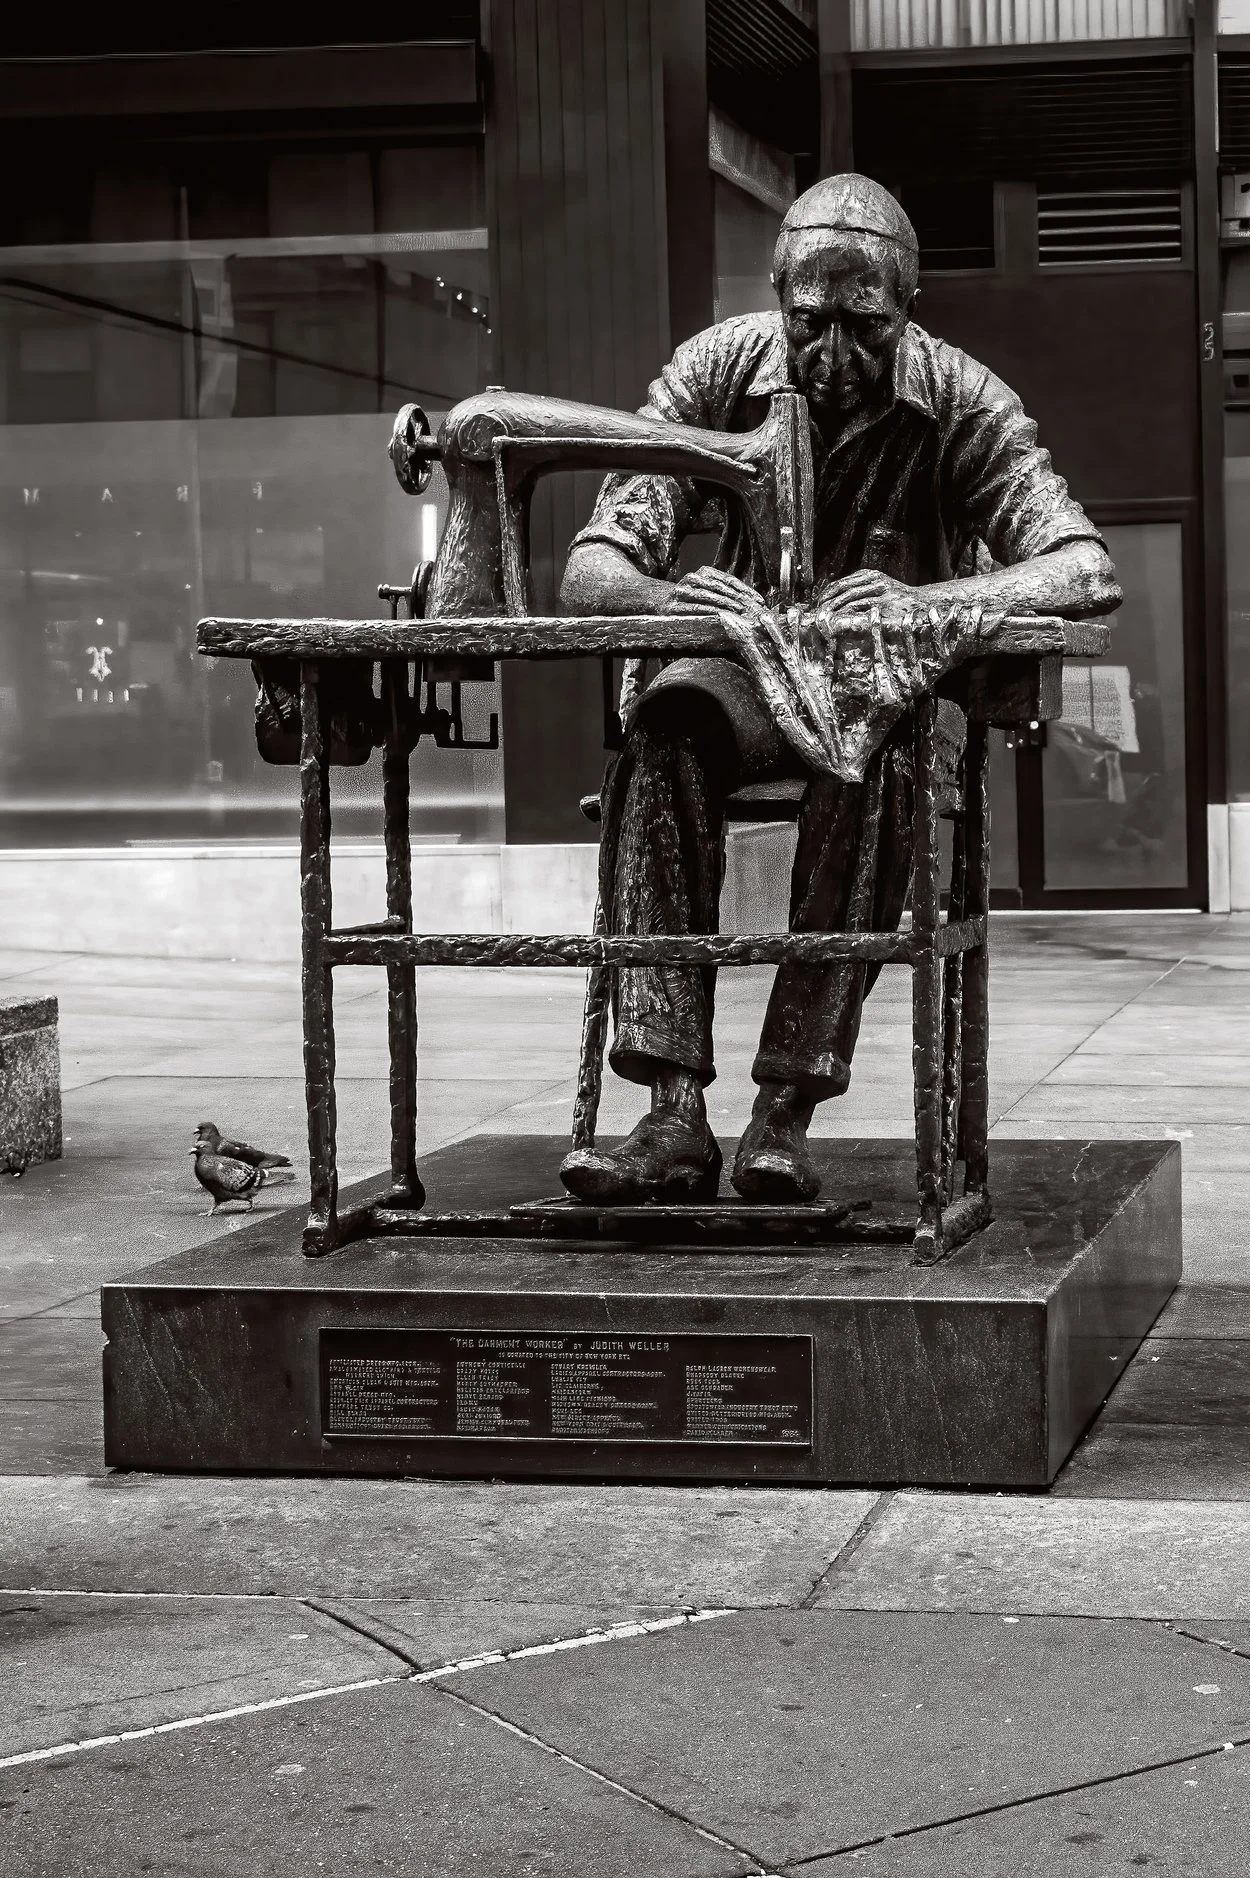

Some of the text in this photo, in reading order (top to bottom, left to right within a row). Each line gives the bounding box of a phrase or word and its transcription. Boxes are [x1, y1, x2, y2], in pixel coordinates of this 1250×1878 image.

[478, 1339, 520, 1348] GARMENT
[590, 1341, 623, 1350] JUDITH
[629, 1342, 669, 1352] WELLER
